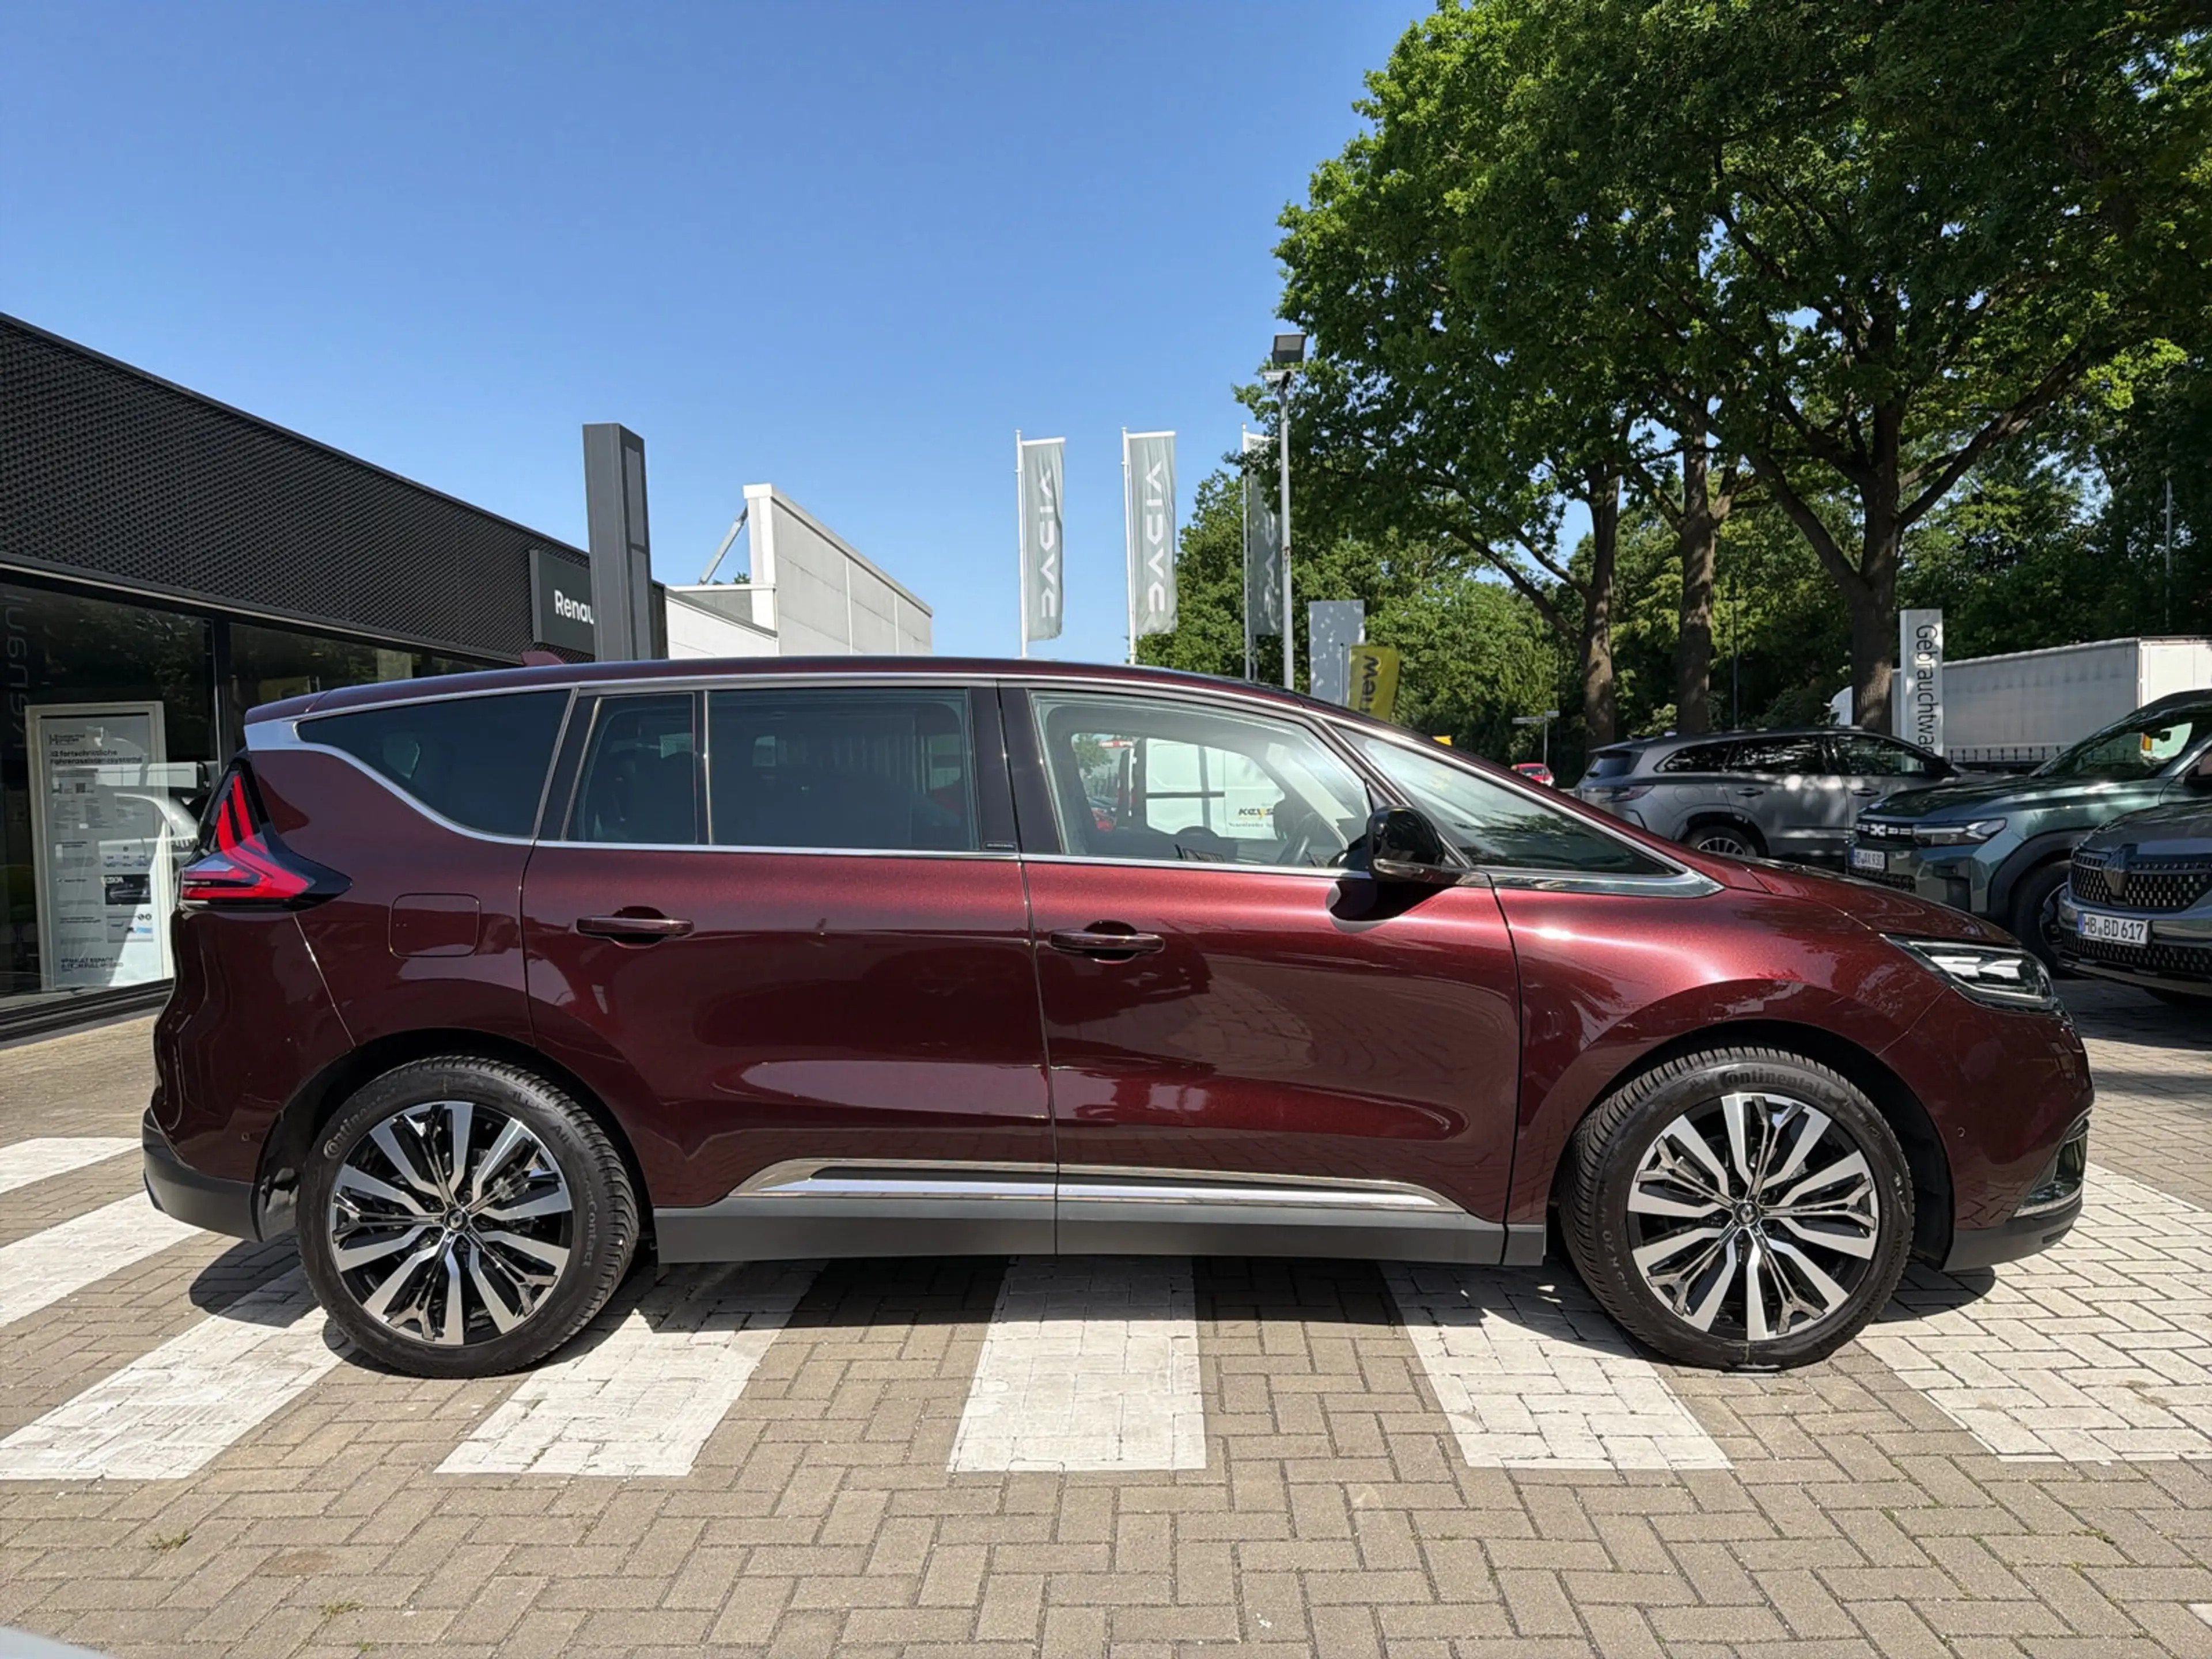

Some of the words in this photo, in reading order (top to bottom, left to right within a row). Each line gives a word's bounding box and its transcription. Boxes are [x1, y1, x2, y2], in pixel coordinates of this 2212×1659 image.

[1145, 460, 1165, 613] DACIA
[2083, 916, 2097, 934] HB
[1718, 1067, 1820, 1096] Continental
